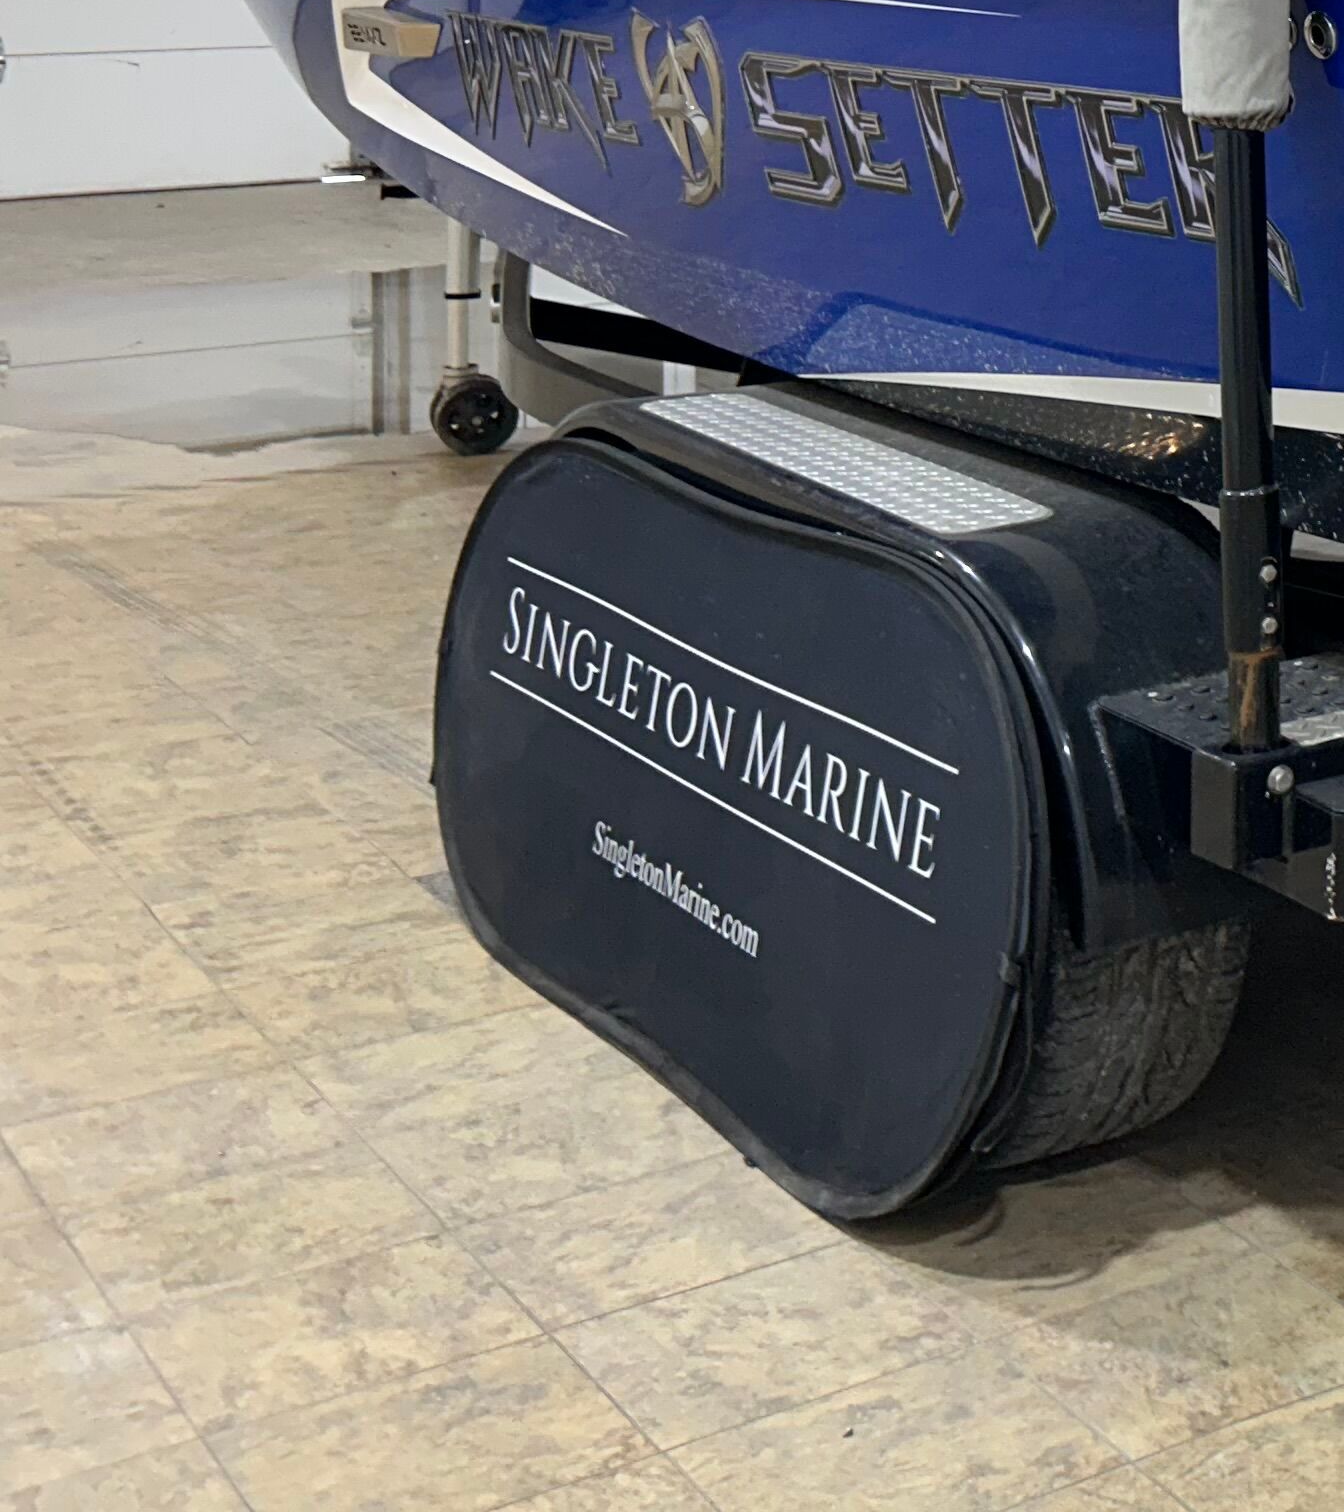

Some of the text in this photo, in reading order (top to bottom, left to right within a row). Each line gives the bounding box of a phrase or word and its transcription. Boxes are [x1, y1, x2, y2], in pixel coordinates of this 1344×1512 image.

[446, 10, 642, 176] WAKE
[502, 586, 940, 879] SINGLETON MARINE
[592, 820, 759, 958] SingletonMarine.com
